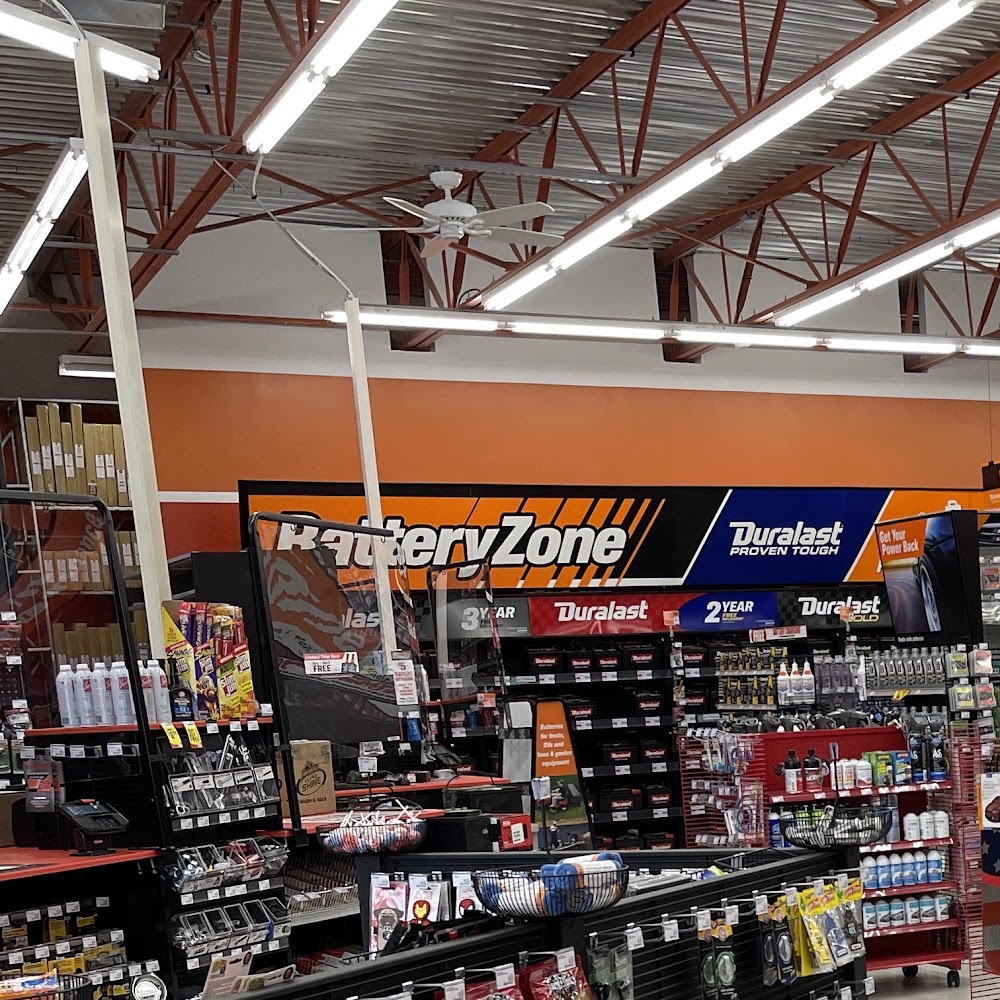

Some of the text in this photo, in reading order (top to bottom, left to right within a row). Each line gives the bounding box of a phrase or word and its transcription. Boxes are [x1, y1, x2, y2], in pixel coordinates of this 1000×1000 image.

[729, 521, 844, 546] Duralast
[879, 529, 906, 544] Get Your
[730, 546, 839, 556] PROVEN TOUGH
[882, 539, 919, 556] Power Back
[479, 606, 515, 620] YAR
[554, 600, 649, 622] Duralast
[704, 601, 722, 624] 2
[722, 601, 754, 613] YEAR
[461, 606, 480, 631] 3
[313, 664, 332, 673] FREE
